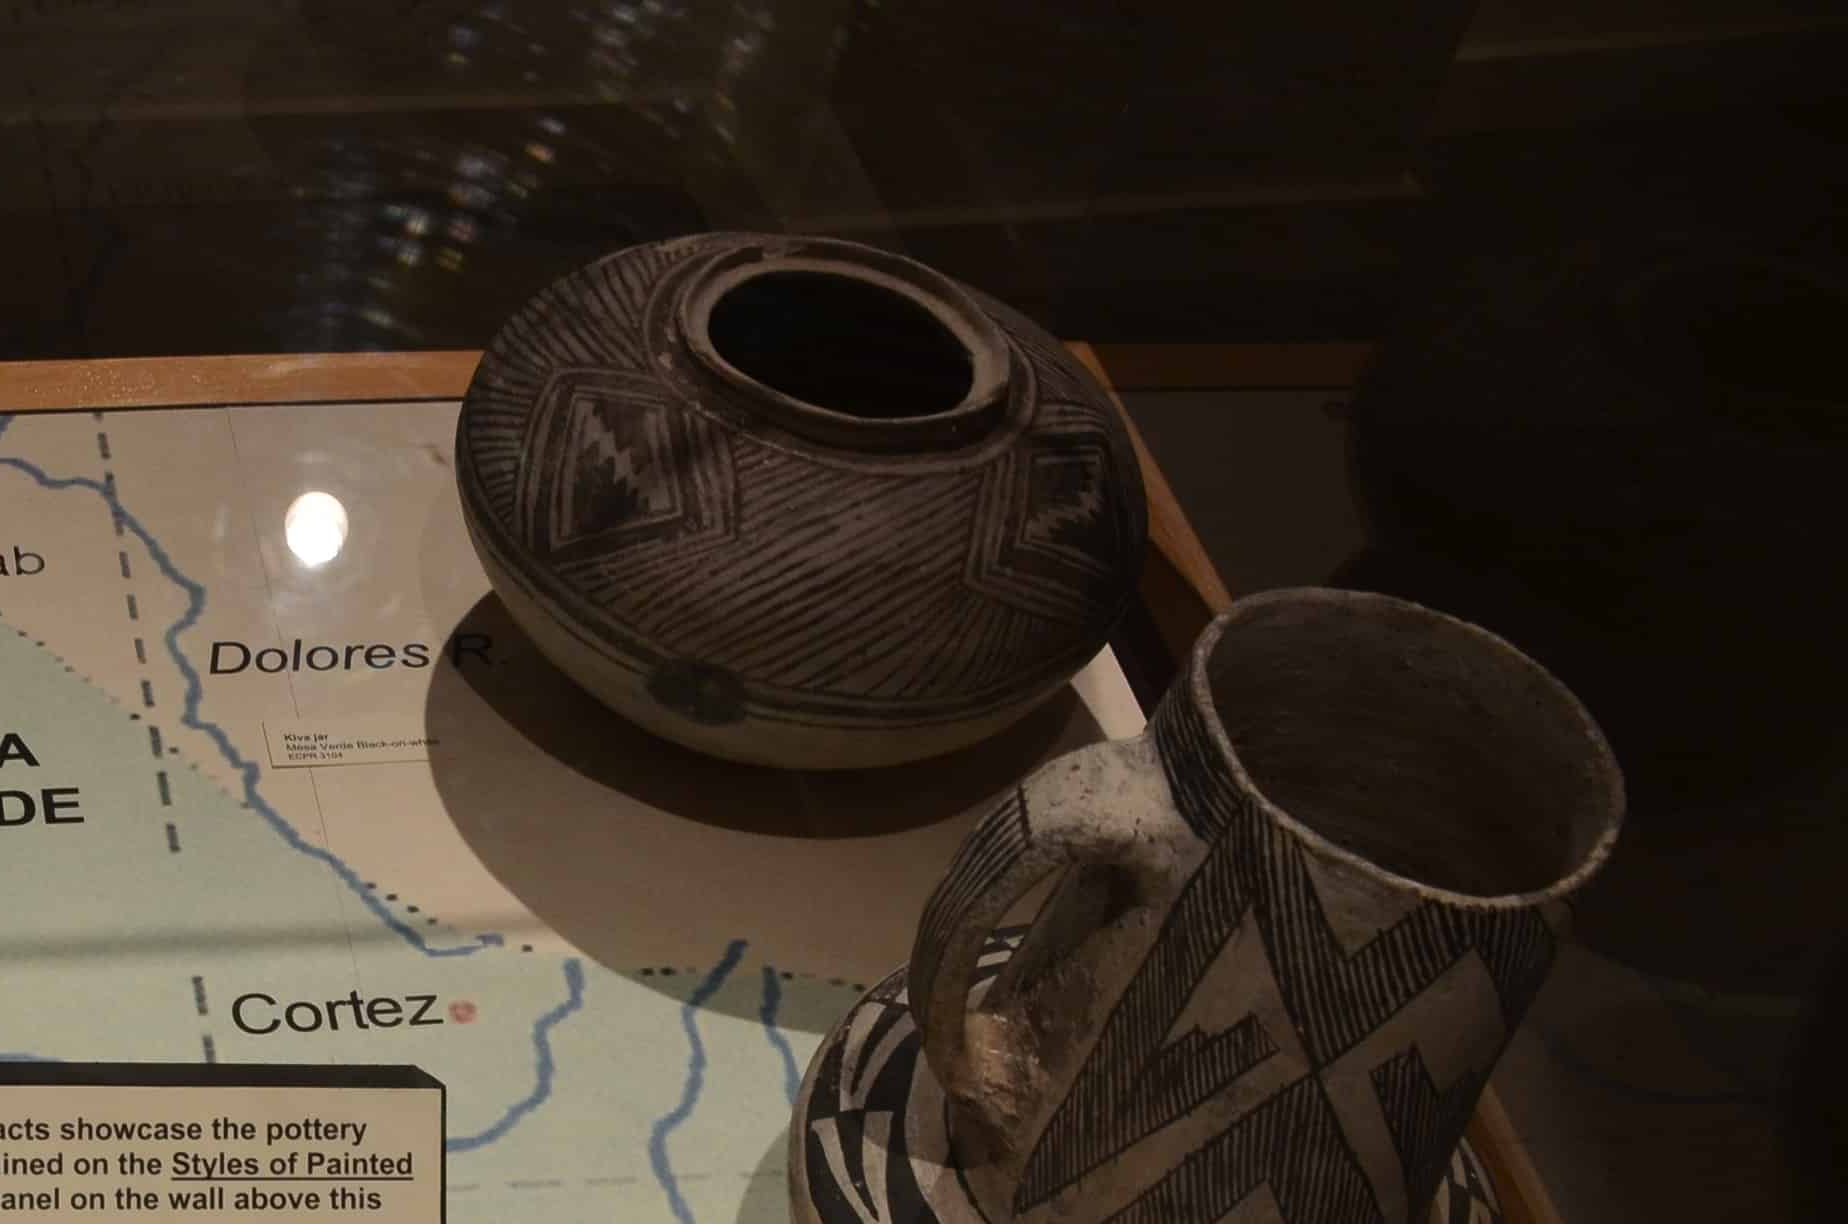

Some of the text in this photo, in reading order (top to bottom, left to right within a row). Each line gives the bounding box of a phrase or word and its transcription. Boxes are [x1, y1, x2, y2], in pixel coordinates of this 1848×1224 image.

[209, 638, 430, 676] Dolores
[229, 992, 444, 1036] Cortez
[59, 1117, 203, 1141] showcase
[212, 1117, 257, 1141] the
[265, 1118, 368, 1148] pottery
[73, 1157, 110, 1176] on
[117, 1152, 163, 1176] the
[171, 1152, 260, 1180] Styles
[269, 1152, 298, 1176] of
[306, 1152, 414, 1177] Painted
[69, 1193, 106, 1211] on
[113, 1188, 159, 1211] the
[167, 1188, 225, 1211] wall
[234, 1188, 322, 1211] above
[330, 1188, 383, 1211] this
